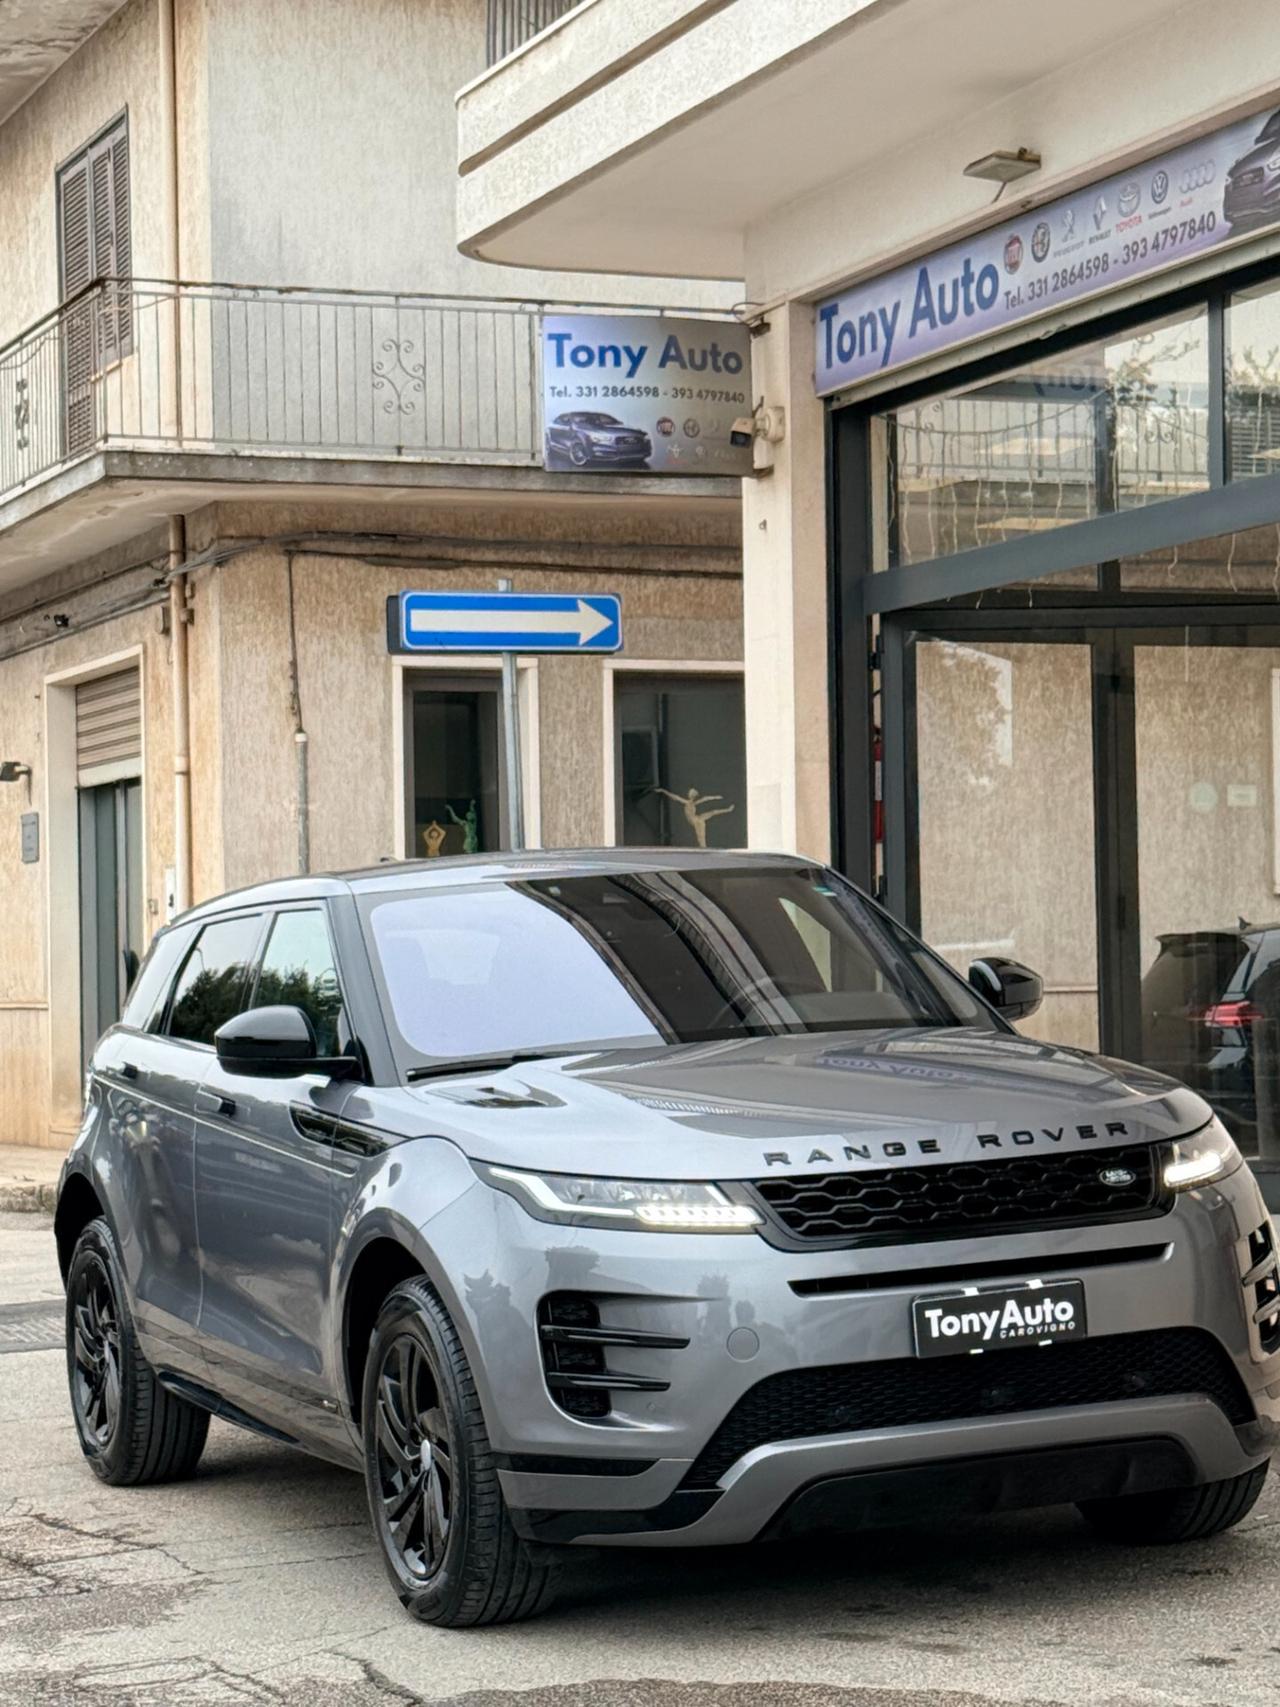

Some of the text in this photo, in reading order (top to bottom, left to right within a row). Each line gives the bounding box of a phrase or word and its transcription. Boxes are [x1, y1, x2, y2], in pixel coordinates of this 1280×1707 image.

[1004, 287, 1024, 310] Tel.
[1028, 276, 1049, 300] 331
[1052, 253, 1110, 293] 2864598
[1122, 239, 1149, 265] 393
[1151, 211, 1217, 252] 4797840
[819, 258, 1000, 367] Tony Auto
[547, 333, 743, 378] Tony Auto
[550, 386, 572, 398] Tel.
[576, 386, 598, 398] 331
[602, 386, 660, 398] 2864598
[671, 388, 694, 400] 393
[696, 390, 745, 404] 4797840
[763, 1122, 1129, 1167] RANGE ROVER
[1000, 1322, 1076, 1339] CAROVIGNO
